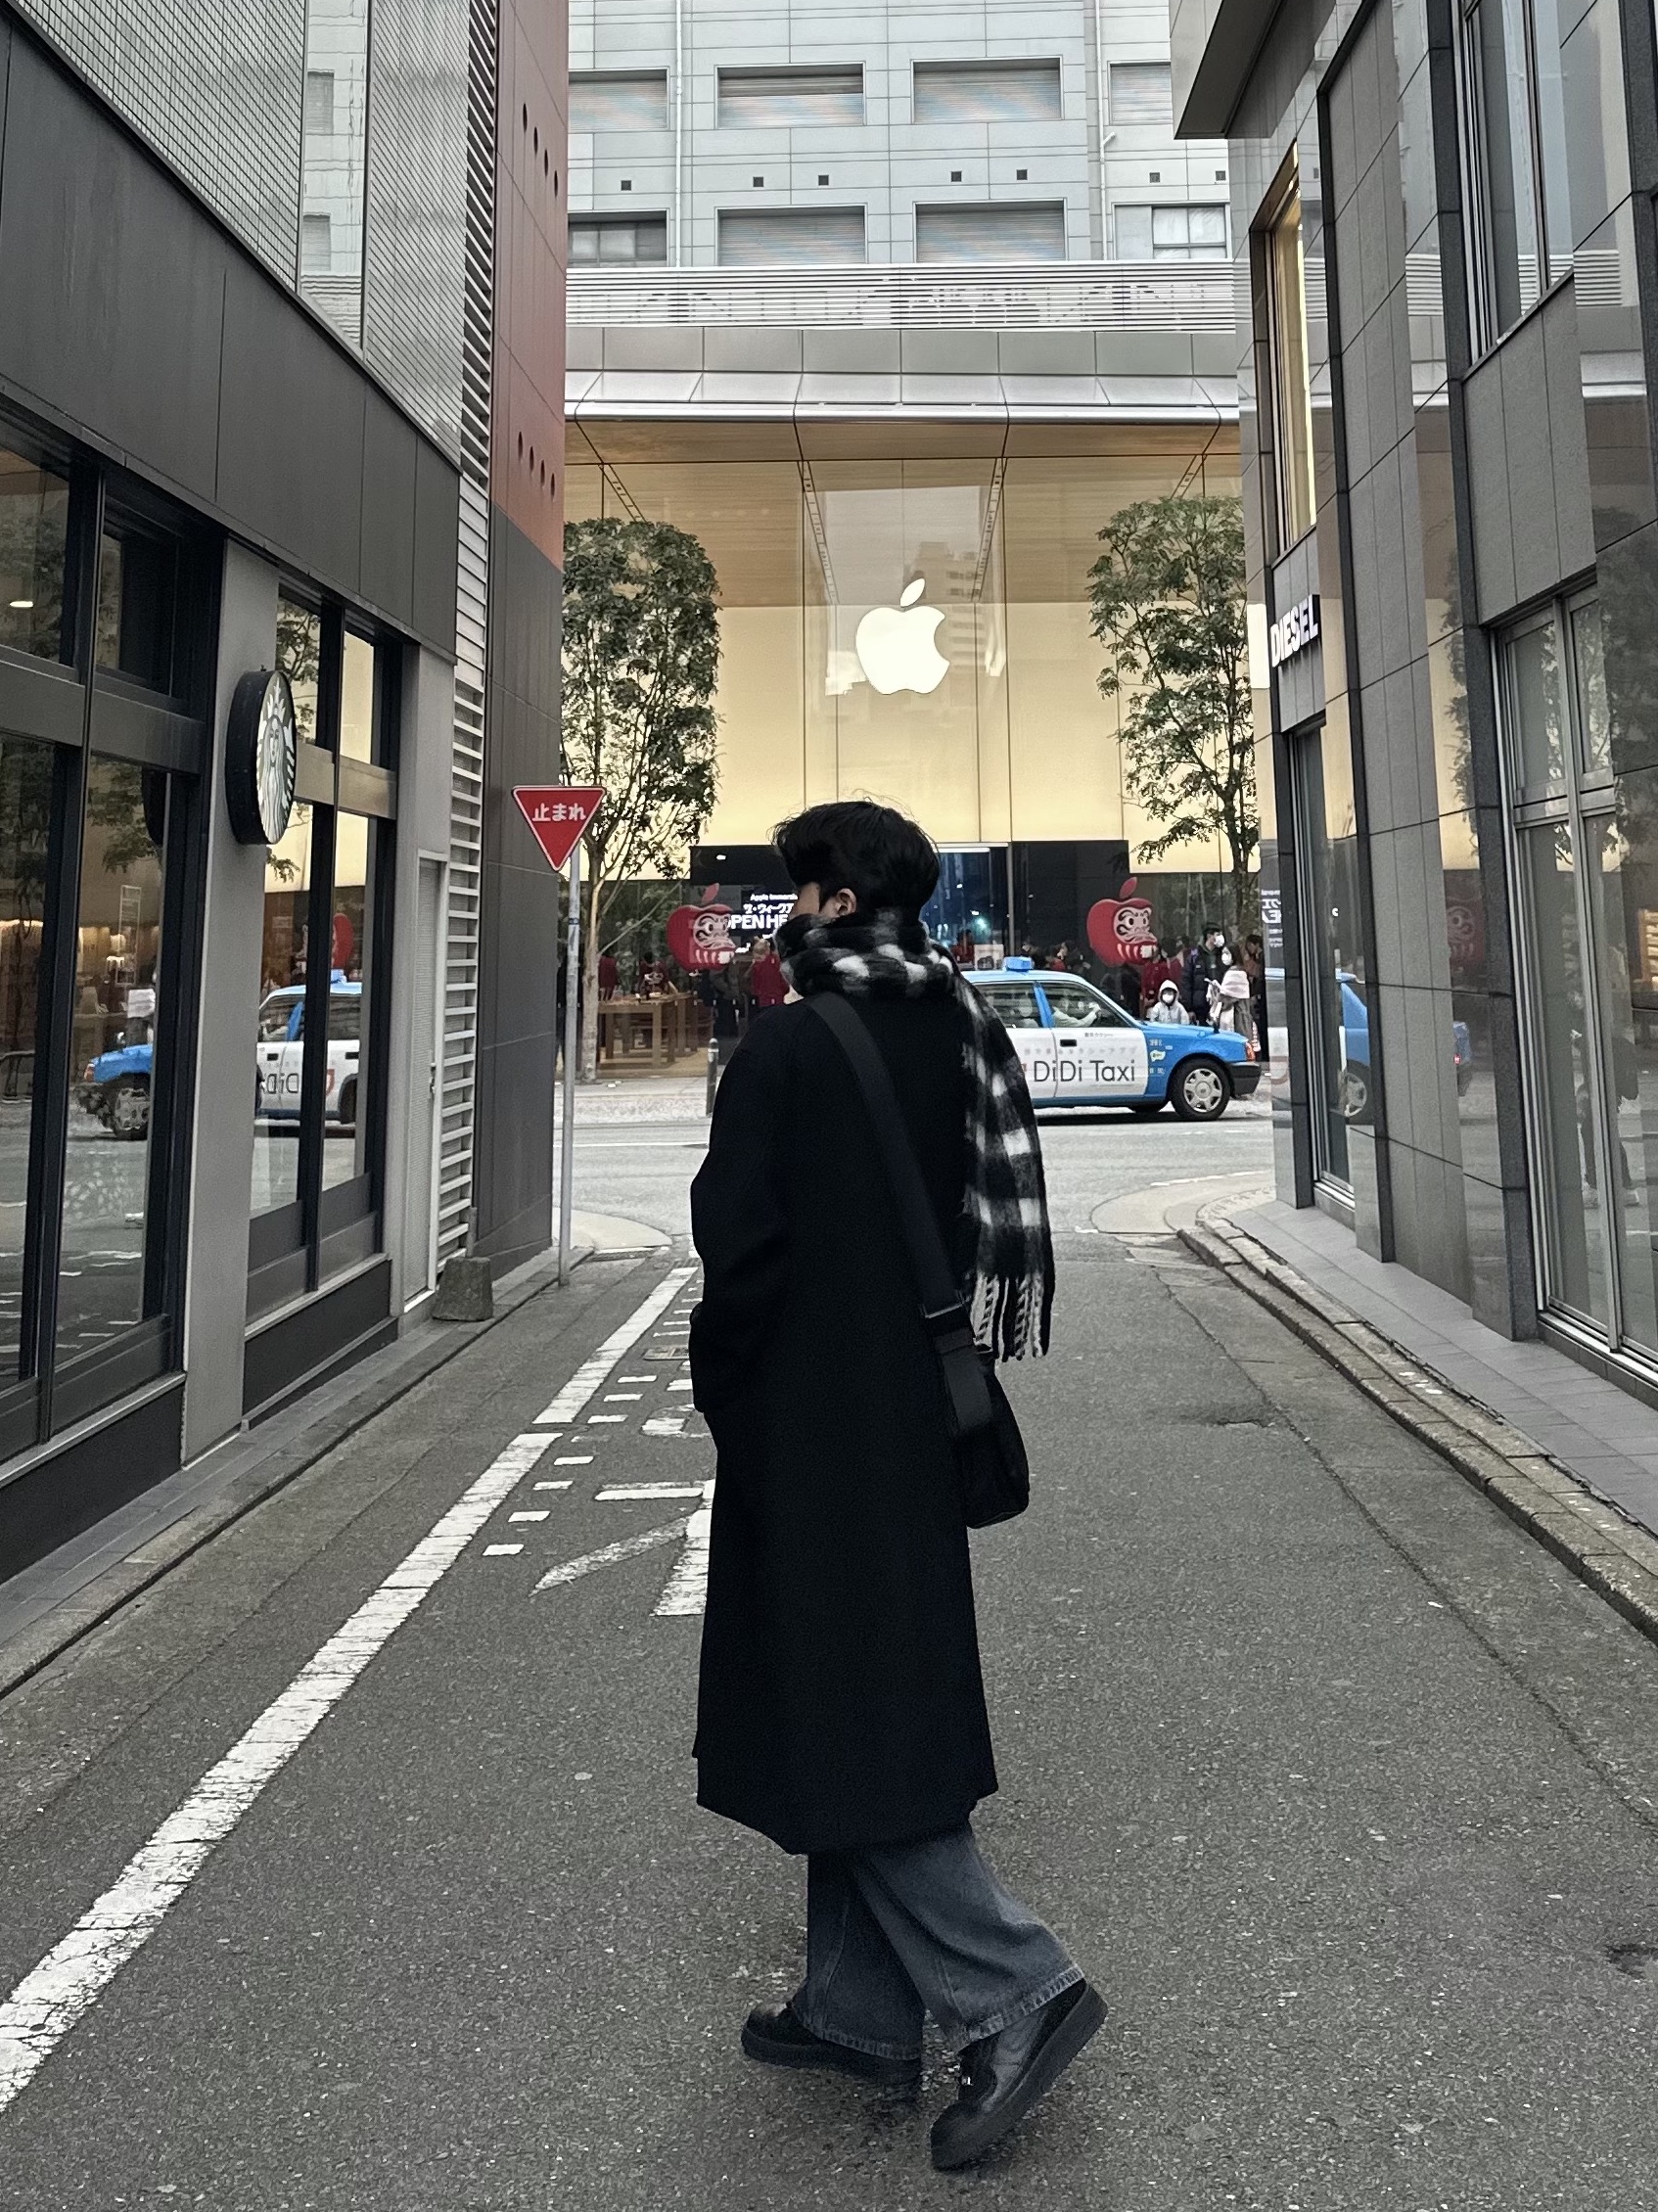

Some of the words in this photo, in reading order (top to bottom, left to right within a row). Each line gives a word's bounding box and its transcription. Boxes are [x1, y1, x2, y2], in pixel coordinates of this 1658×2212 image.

[1270, 599, 1318, 668] DIESEL
[531, 803, 586, 821] 止まれ
[1034, 1059, 1082, 1082] DiDi
[1089, 1059, 1135, 1083] Taxi
